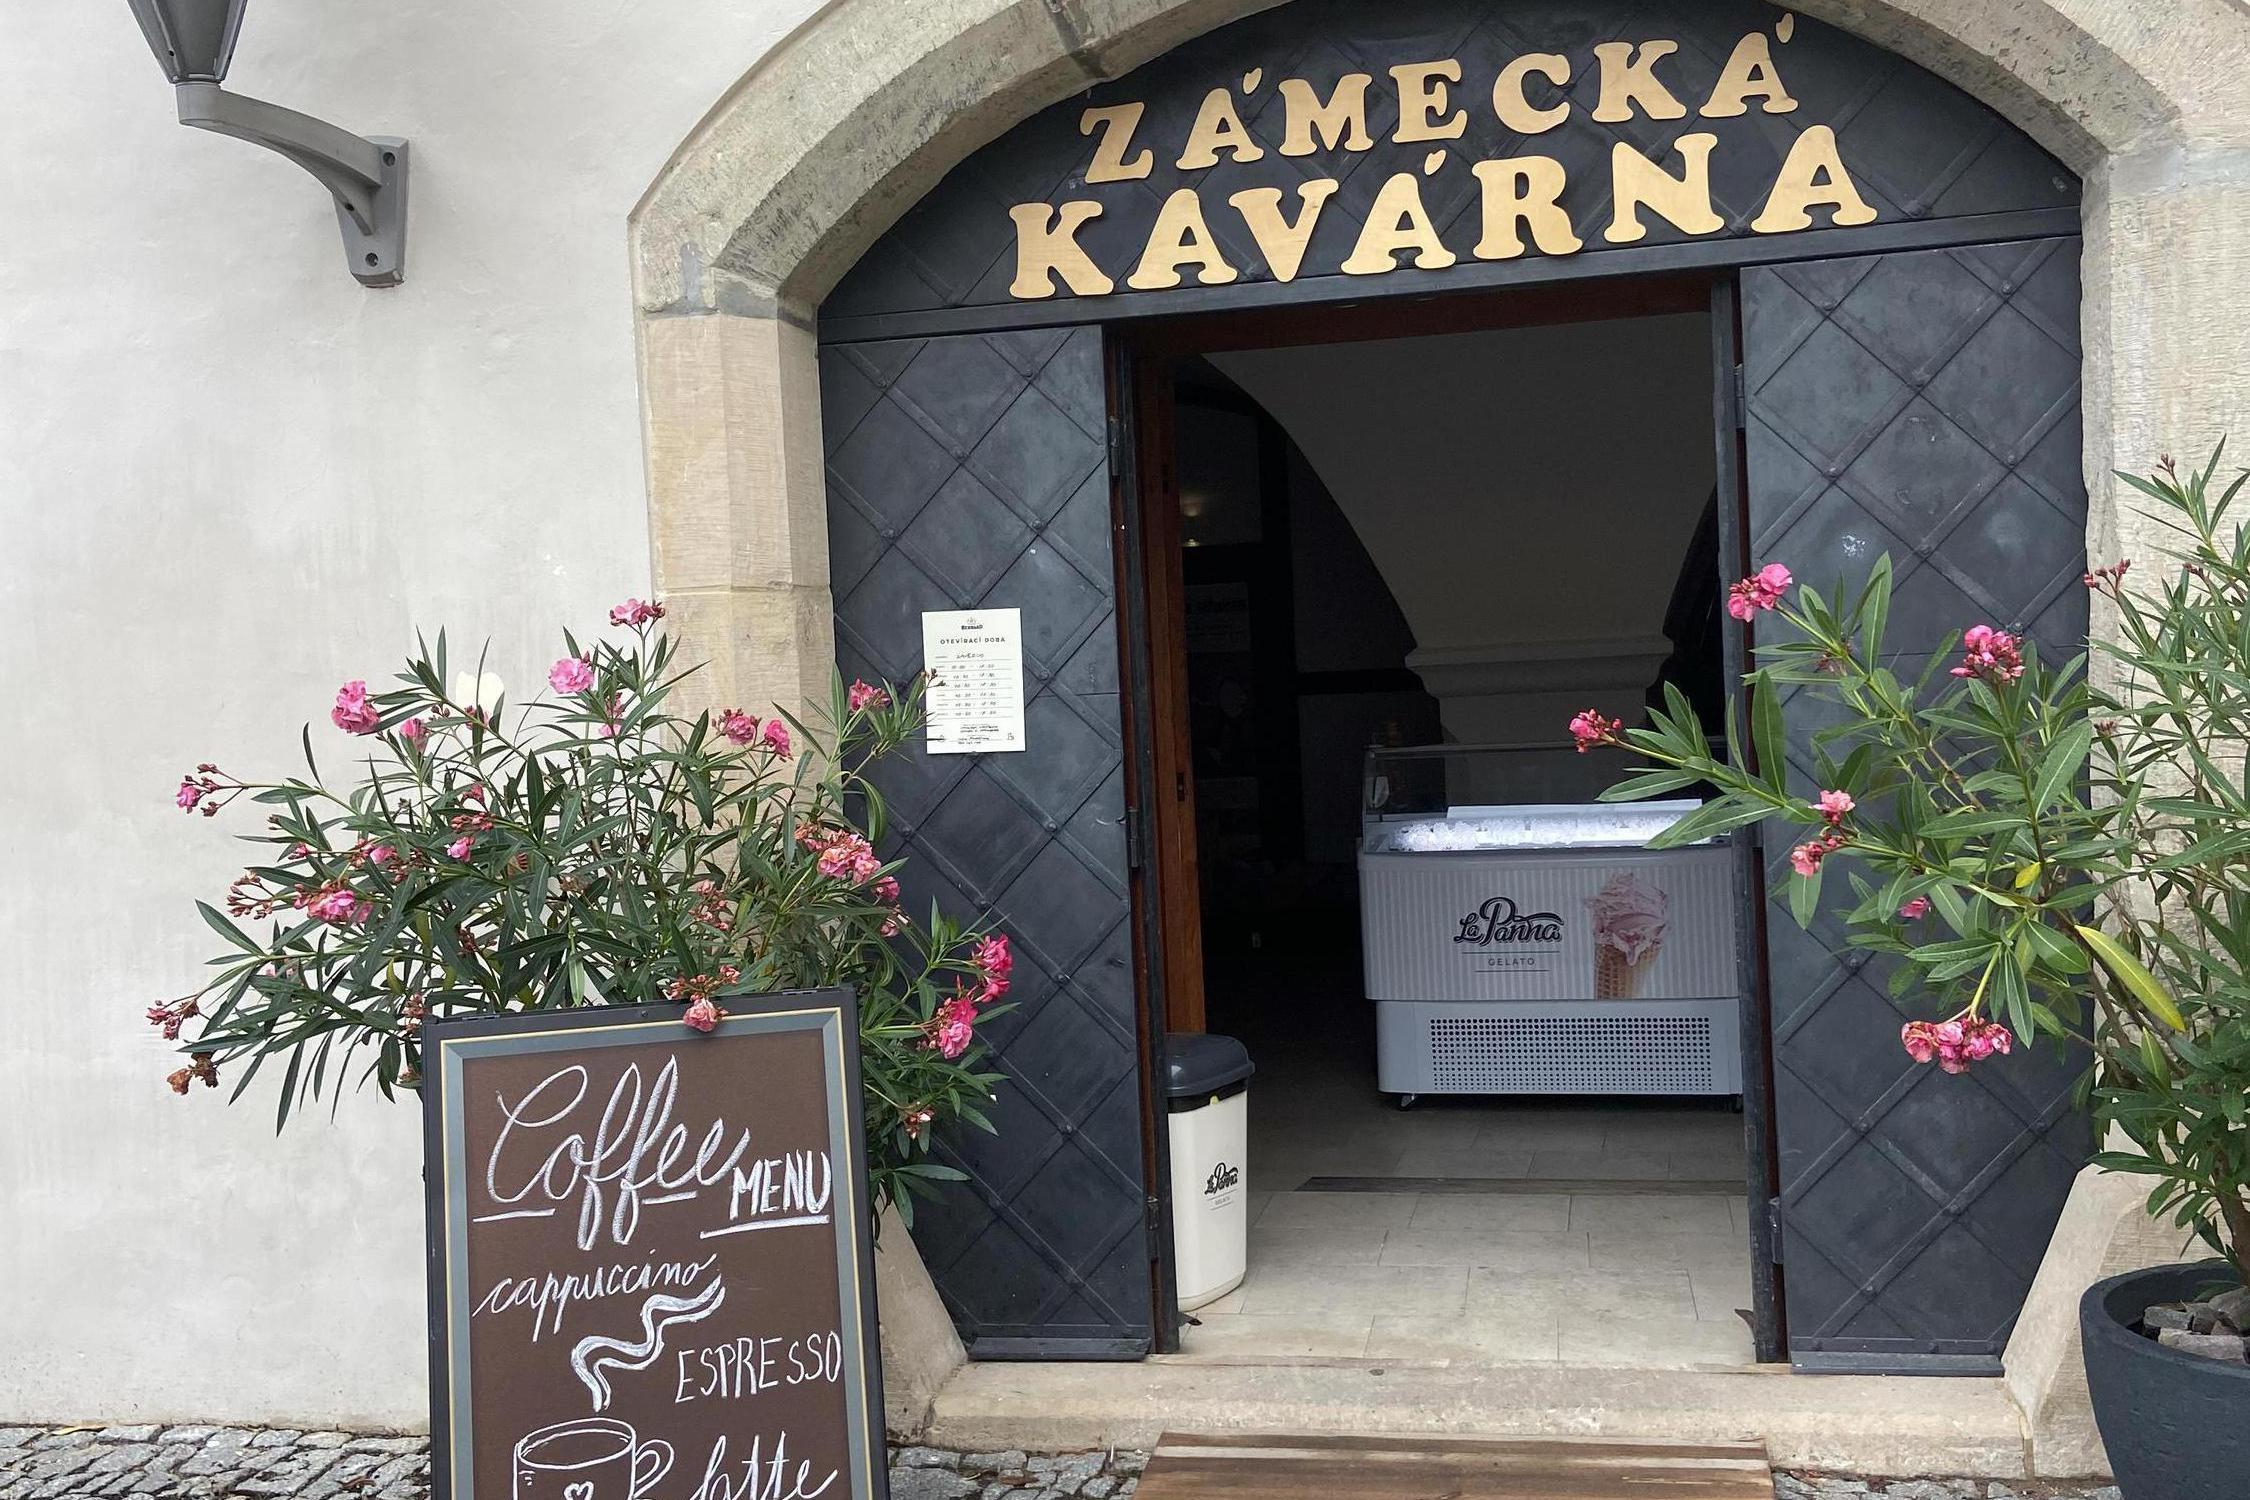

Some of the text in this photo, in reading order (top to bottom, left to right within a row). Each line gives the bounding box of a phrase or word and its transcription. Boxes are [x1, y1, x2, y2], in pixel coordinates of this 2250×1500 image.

[1079, 12, 1798, 184] ZÁMECKÁ
[1008, 124, 1877, 300] KAVÁRNA
[1453, 896, 1564, 947] La Panna
[1488, 957, 1535, 966] GELATO
[486, 1053, 832, 1251] Coffee MENU
[472, 1248, 718, 1343] cappuccino
[674, 1330, 842, 1404] ESPRESSO
